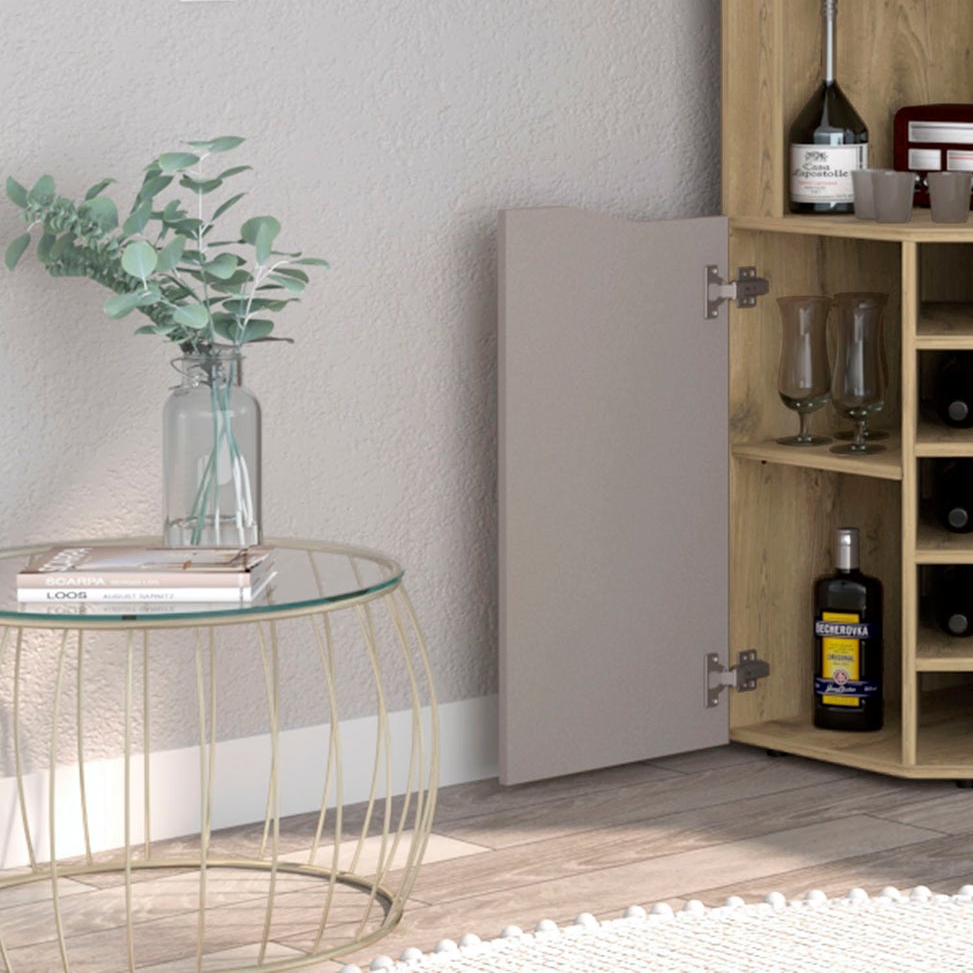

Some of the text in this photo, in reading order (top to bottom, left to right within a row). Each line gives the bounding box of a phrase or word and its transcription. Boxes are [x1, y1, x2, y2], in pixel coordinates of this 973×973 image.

[801, 162, 831, 171] Casa
[45, 576, 106, 586] SCARPA
[46, 590, 87, 599] LOOS
